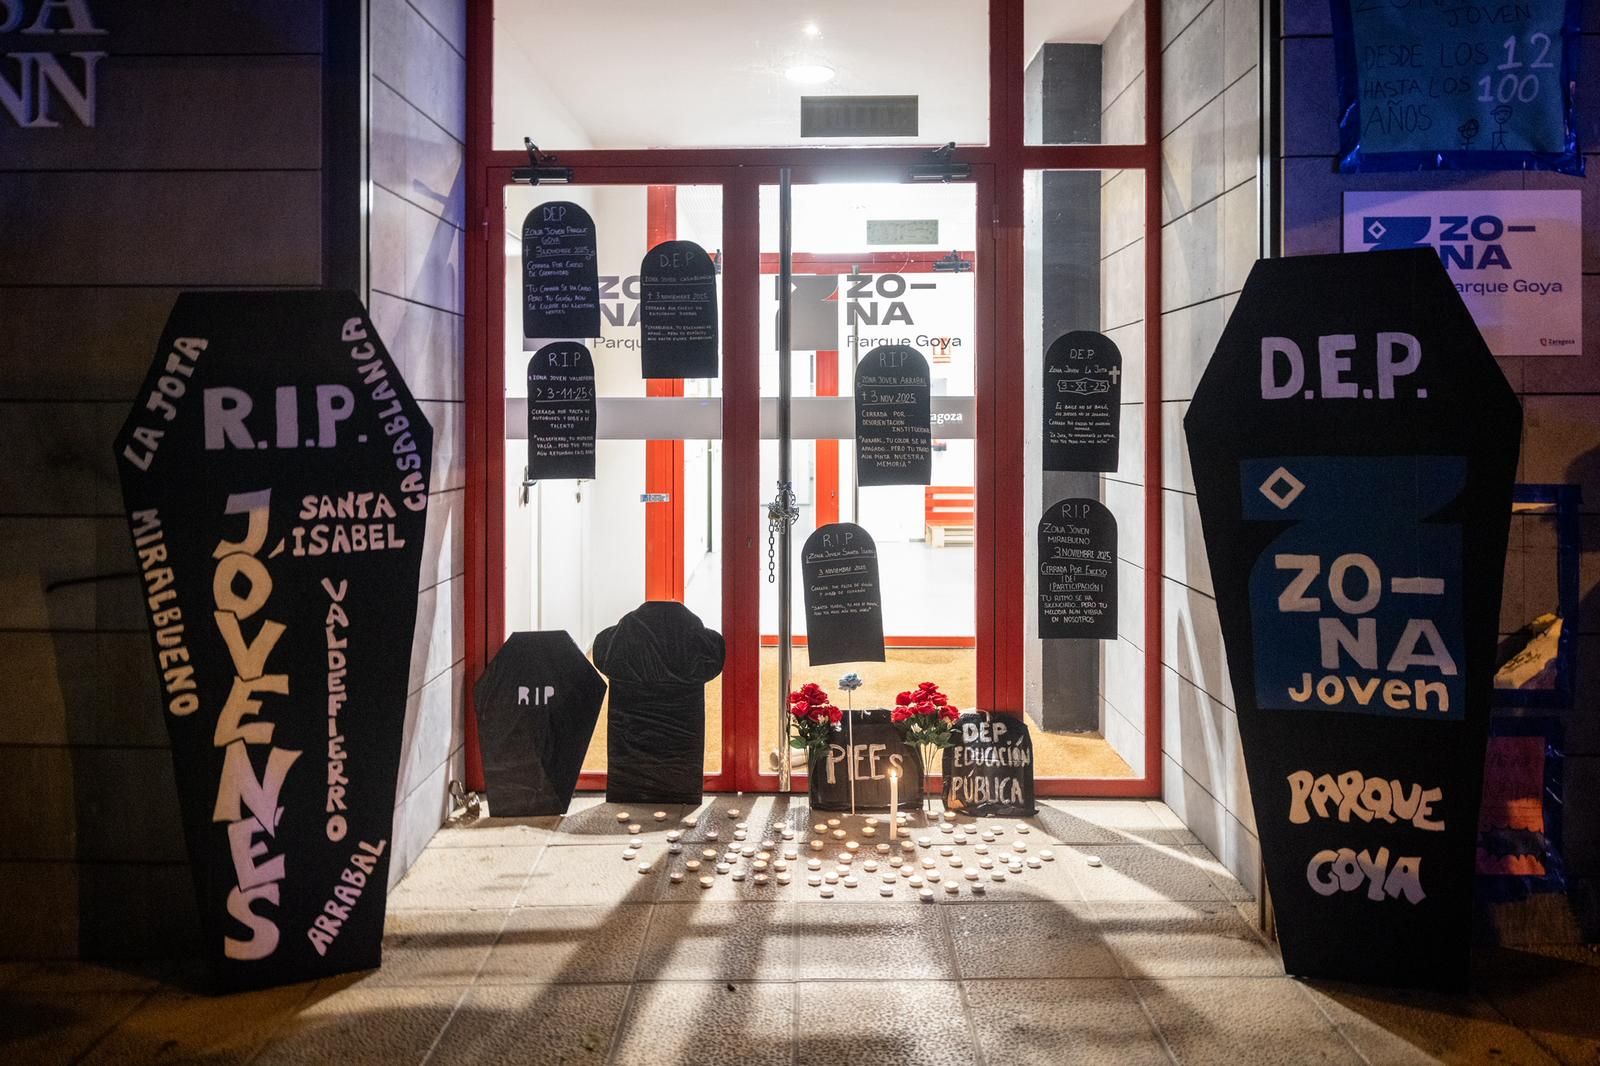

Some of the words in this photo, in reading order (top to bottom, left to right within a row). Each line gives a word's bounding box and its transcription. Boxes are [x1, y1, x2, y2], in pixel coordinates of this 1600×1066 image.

[1445, 5, 1531, 28] JOVEN
[1364, 44, 1425, 70] DESDE
[1440, 42, 1489, 68] LOS
[1497, 32, 1554, 71] 12
[1363, 78, 1424, 99] HASTA
[1428, 76, 1472, 99] LOS
[1477, 73, 1540, 104] 100
[1363, 101, 1433, 137] AÑOS
[543, 206, 567, 221] DEP
[1440, 244, 1513, 270] NA
[1454, 281, 1509, 296] arque
[1513, 279, 1563, 296] Goya
[846, 301, 915, 326] NA
[915, 334, 962, 351] Goya
[1260, 331, 1429, 400] D.E.P.
[123, 425, 166, 472] LA
[146, 336, 210, 421] JOTA
[341, 316, 426, 511] CASABLANCA
[870, 390, 878, 403] 3
[895, 392, 916, 404] 2025
[202, 384, 368, 450] R.I.P.
[930, 413, 963, 425] agoza
[299, 491, 398, 521] SANTA
[291, 523, 406, 558] ISABEL
[1047, 536, 1091, 545] MIRALBUENO
[131, 508, 200, 717] MIRALBUENO
[1318, 617, 1458, 676] NA
[320, 577, 350, 843] VALDEFIERRO
[517, 685, 555, 706] RIP
[954, 735, 1031, 768] EDUCACIÓN
[951, 767, 1025, 805] PÚBLICA
[1286, 769, 1446, 832] PARQUE
[1306, 846, 1428, 905] GOYA
[306, 839, 388, 957] ARRABAL
